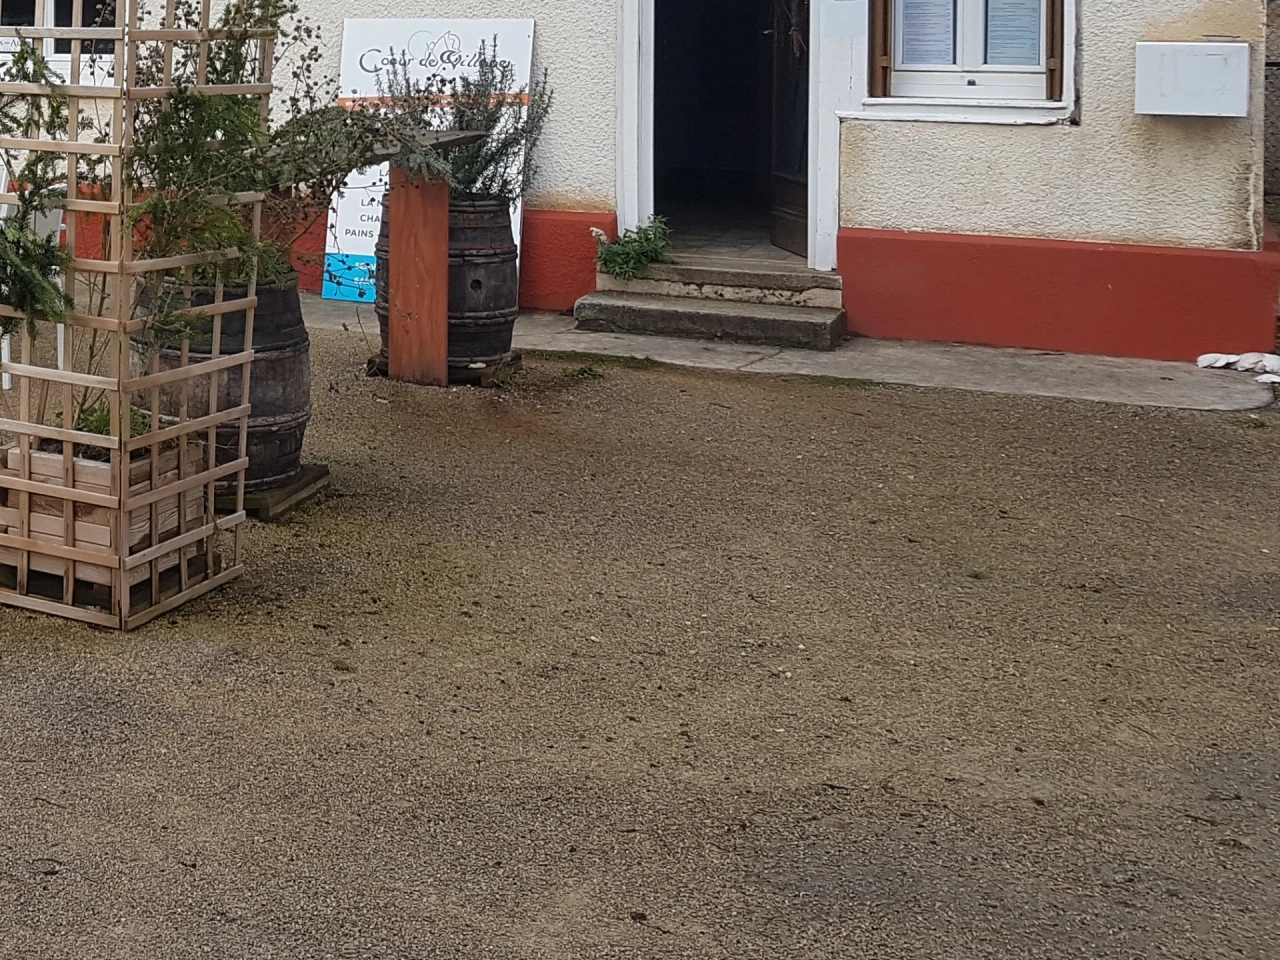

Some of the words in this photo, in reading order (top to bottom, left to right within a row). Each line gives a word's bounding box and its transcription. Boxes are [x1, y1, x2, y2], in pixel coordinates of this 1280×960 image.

[359, 48, 414, 74] Coeur
[418, 51, 439, 68] de
[359, 214, 381, 223] CHA
[345, 228, 375, 238] PAINS
